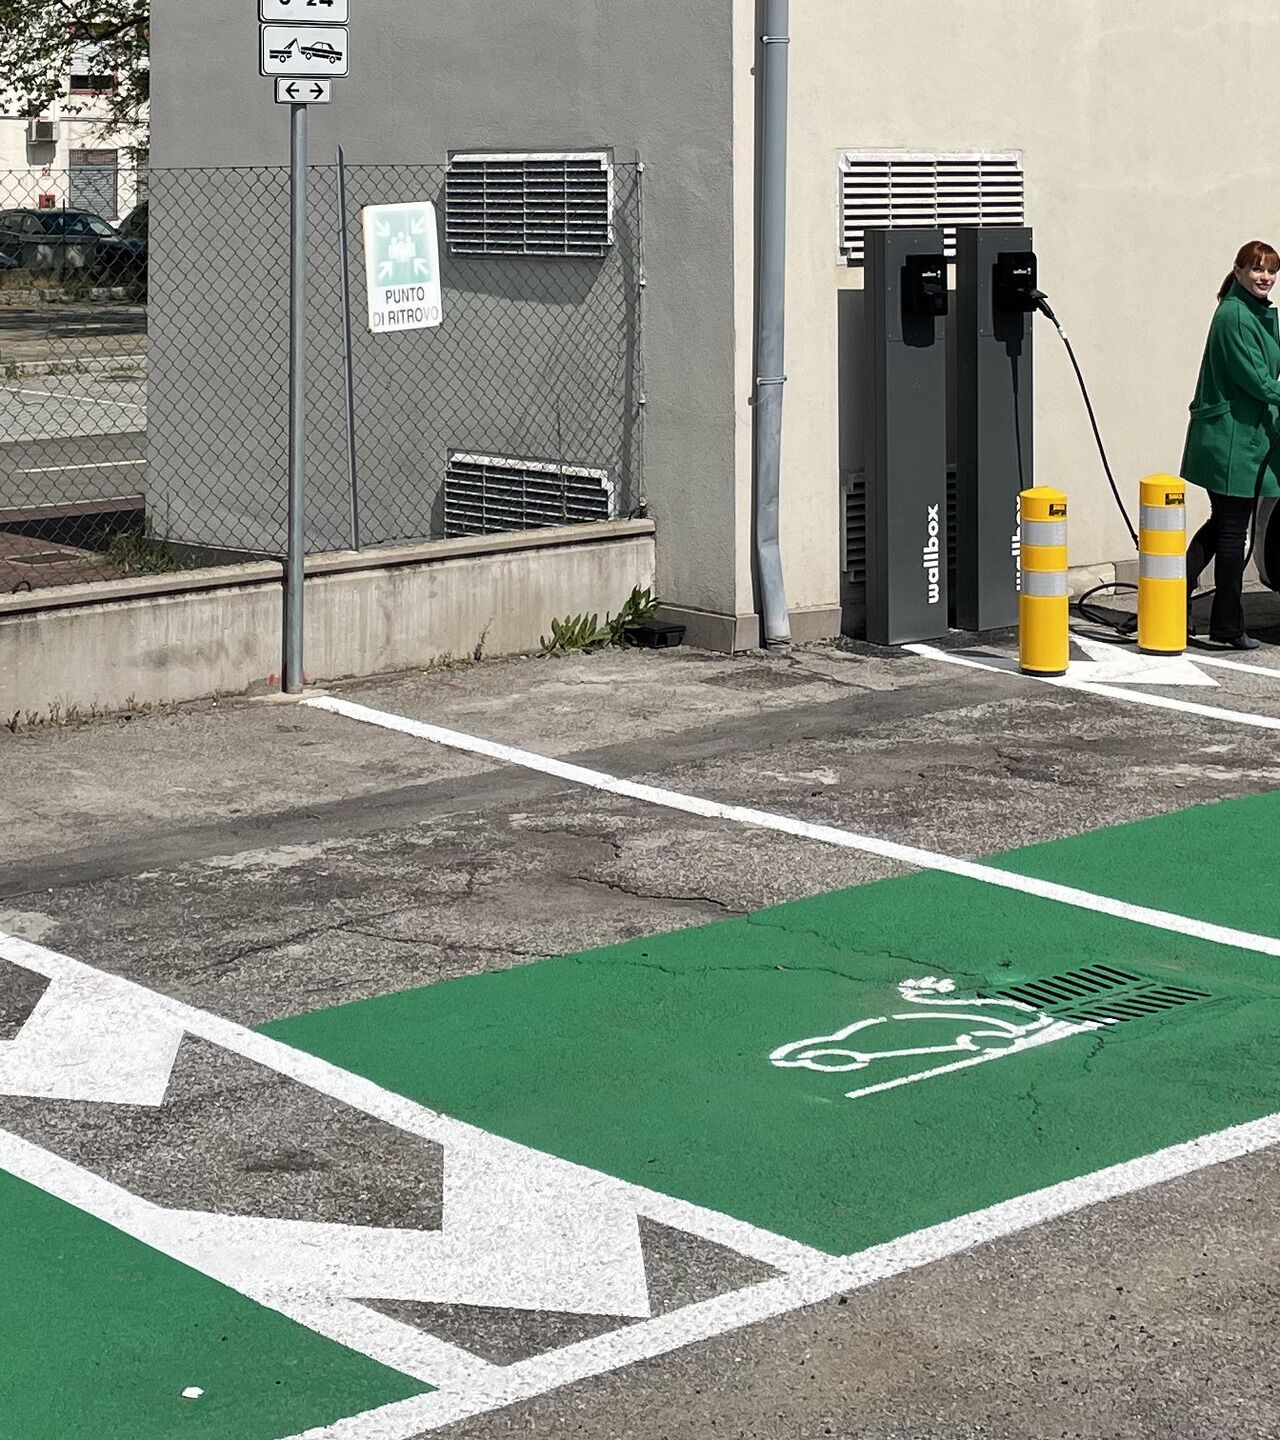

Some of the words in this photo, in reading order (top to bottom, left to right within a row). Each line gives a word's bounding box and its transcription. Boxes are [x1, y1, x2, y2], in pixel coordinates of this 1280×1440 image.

[385, 286, 425, 305] PUNTO
[372, 311, 385, 327] DI
[388, 306, 439, 326] RITROVO
[923, 503, 939, 604] wallbox
